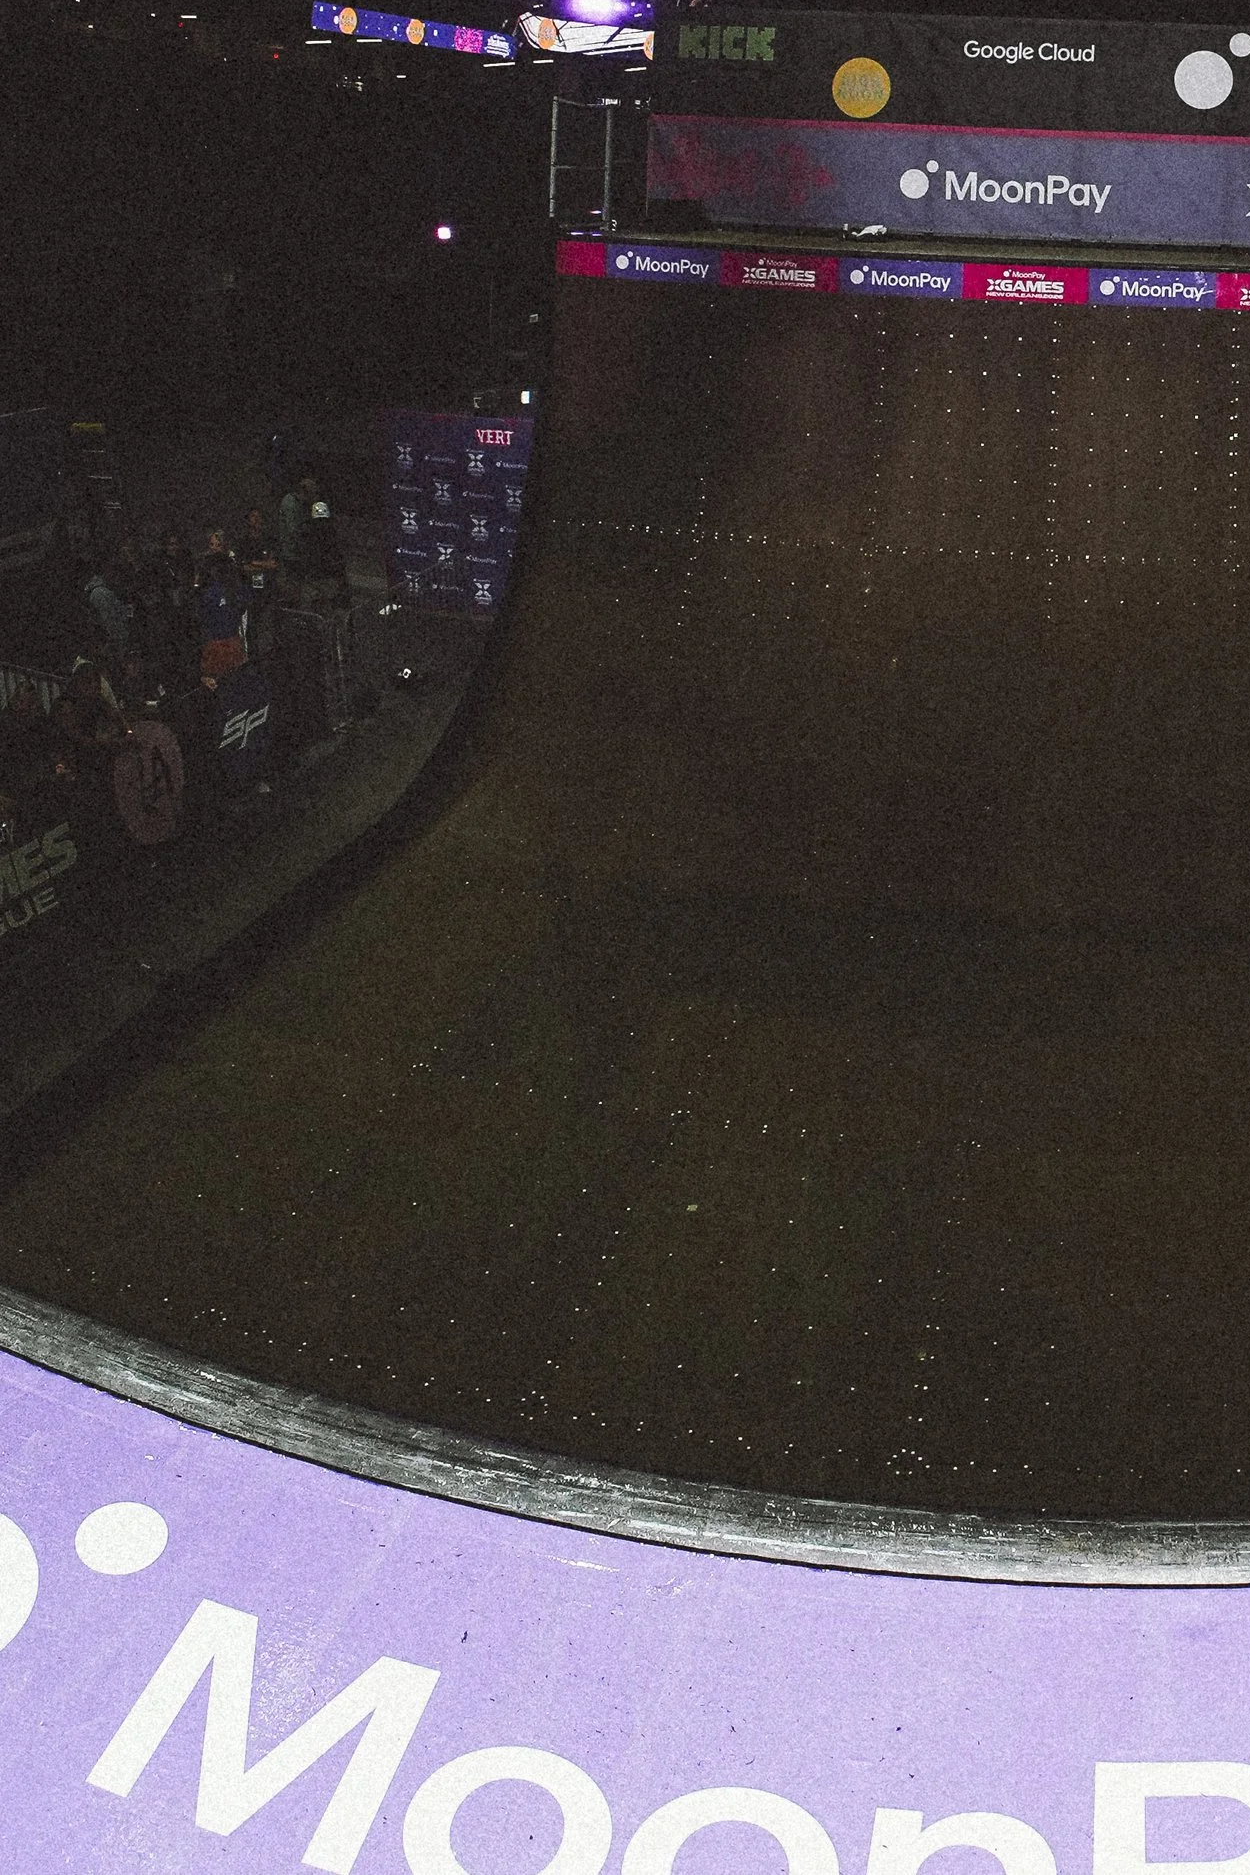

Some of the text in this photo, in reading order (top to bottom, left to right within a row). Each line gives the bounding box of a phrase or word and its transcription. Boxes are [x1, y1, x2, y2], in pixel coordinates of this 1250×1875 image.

[679, 25, 776, 61] KICK
[963, 40, 1095, 64] Google Cloud
[945, 171, 1112, 213] MoonPay
[635, 256, 709, 279] MoonPay
[1012, 270, 1046, 279] MoonPay
[871, 271, 951, 292] MoonPay
[1122, 280, 1202, 301] MoonPay
[476, 429, 514, 445] VERT
